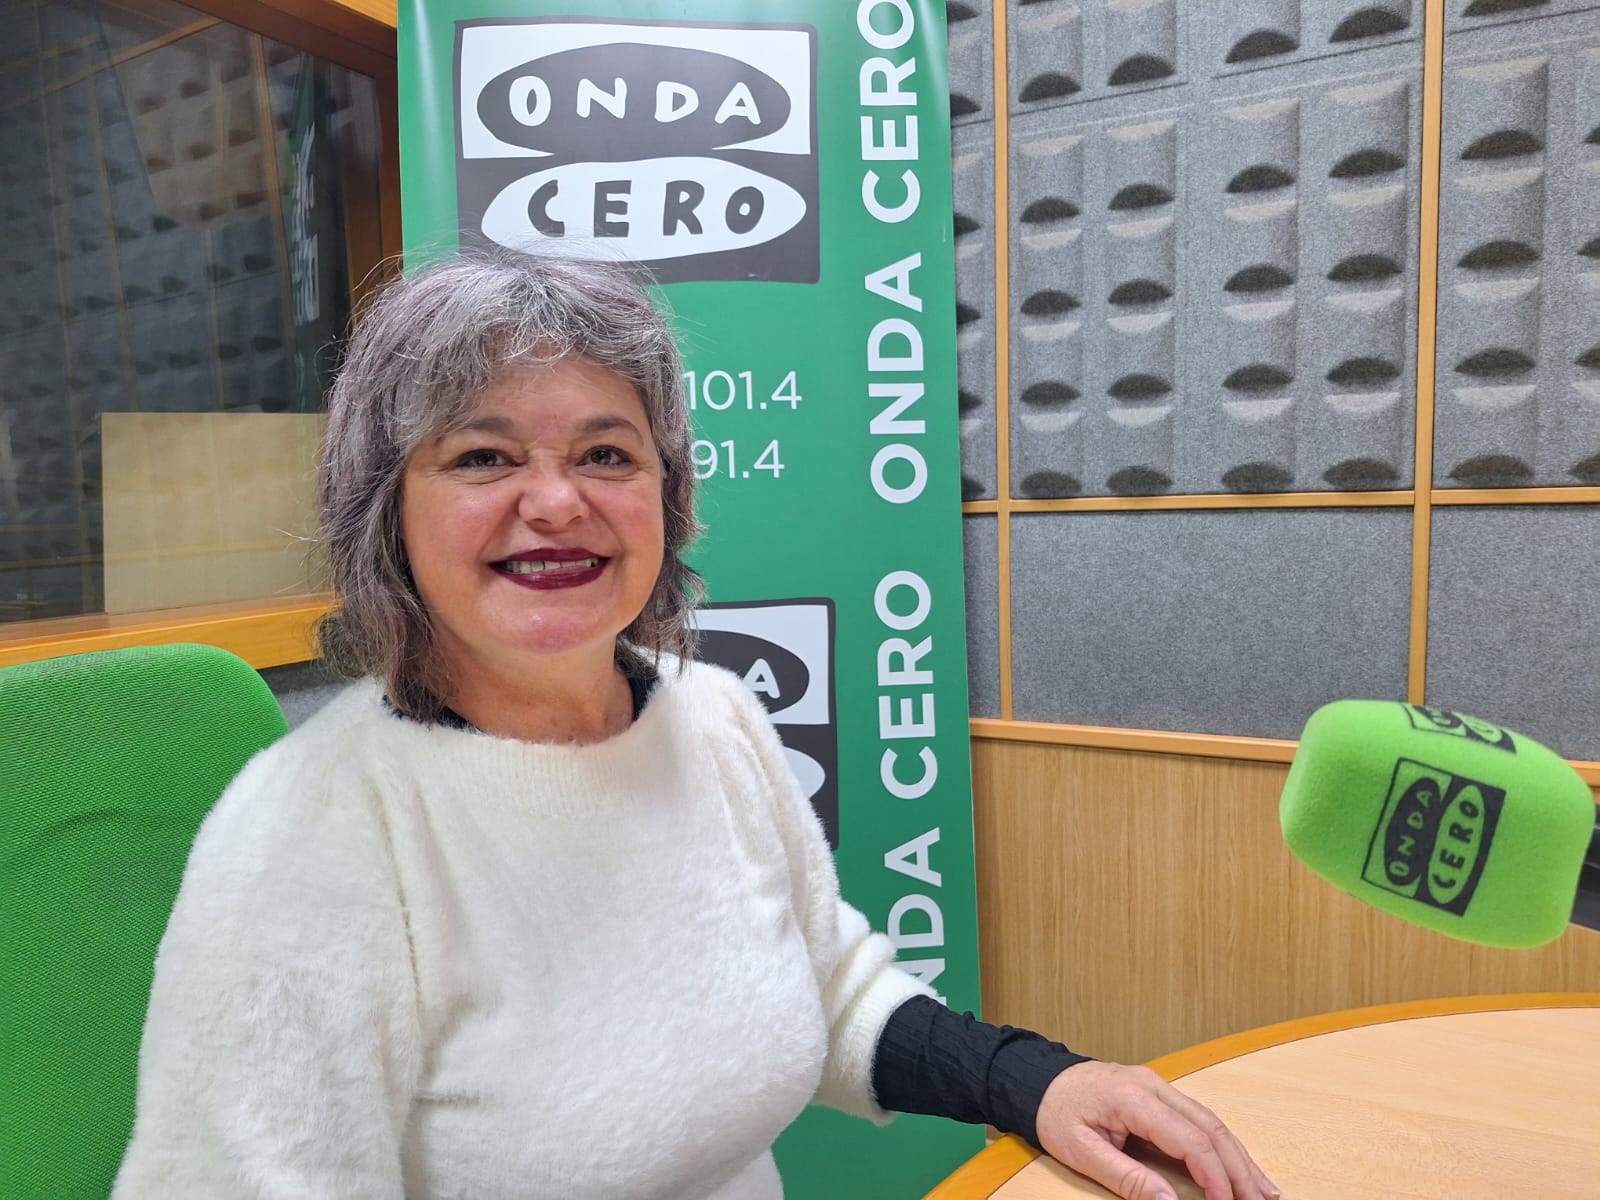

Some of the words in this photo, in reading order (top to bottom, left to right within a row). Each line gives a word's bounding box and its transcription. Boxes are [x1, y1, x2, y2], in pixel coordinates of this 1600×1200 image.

[509, 76, 761, 126] ONDA
[857, 0, 920, 223] CERO
[528, 180, 765, 237] CERO
[683, 370, 803, 410] 101.4
[865, 252, 927, 503] ONDA
[690, 439, 785, 480] 91.4
[875, 571, 937, 799] CERO
[1389, 790, 1433, 877] ONDA
[1432, 800, 1479, 889] CERO
